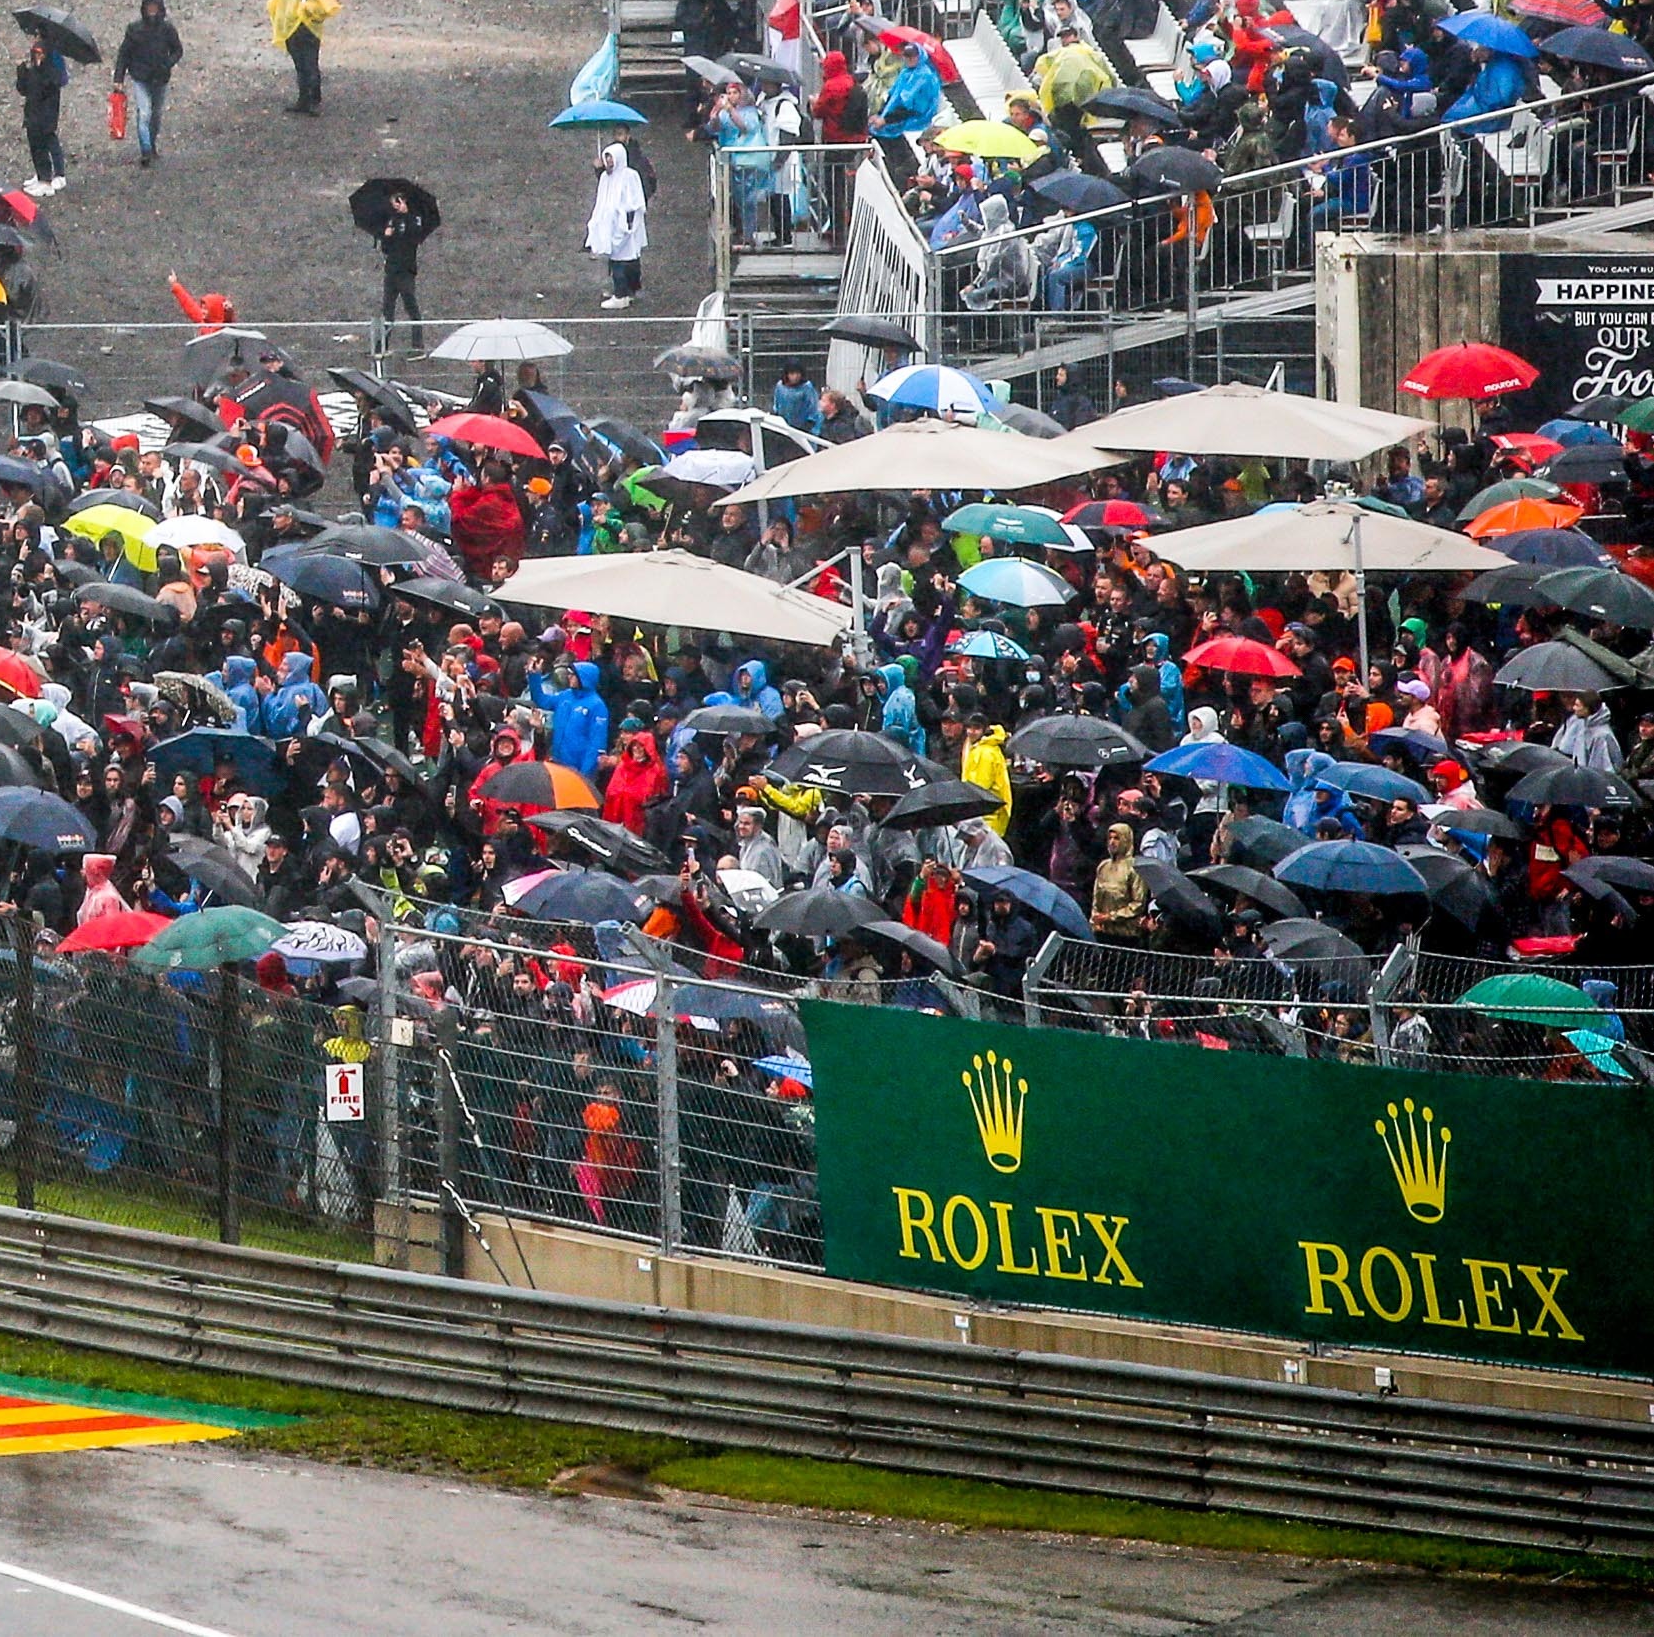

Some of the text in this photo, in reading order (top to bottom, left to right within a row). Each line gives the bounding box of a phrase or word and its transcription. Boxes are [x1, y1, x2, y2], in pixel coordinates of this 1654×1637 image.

[1588, 265, 1608, 274] YOU
[1610, 265, 1638, 274] CAN'T
[1574, 311, 1648, 327] BUT YOU CAN
[1597, 327, 1652, 349] OUR
[1572, 347, 1654, 403] Foo
[330, 1095, 360, 1104] FIRE
[891, 1185, 1145, 1289] ROLEX
[1297, 1239, 1586, 1342] ROLEX
